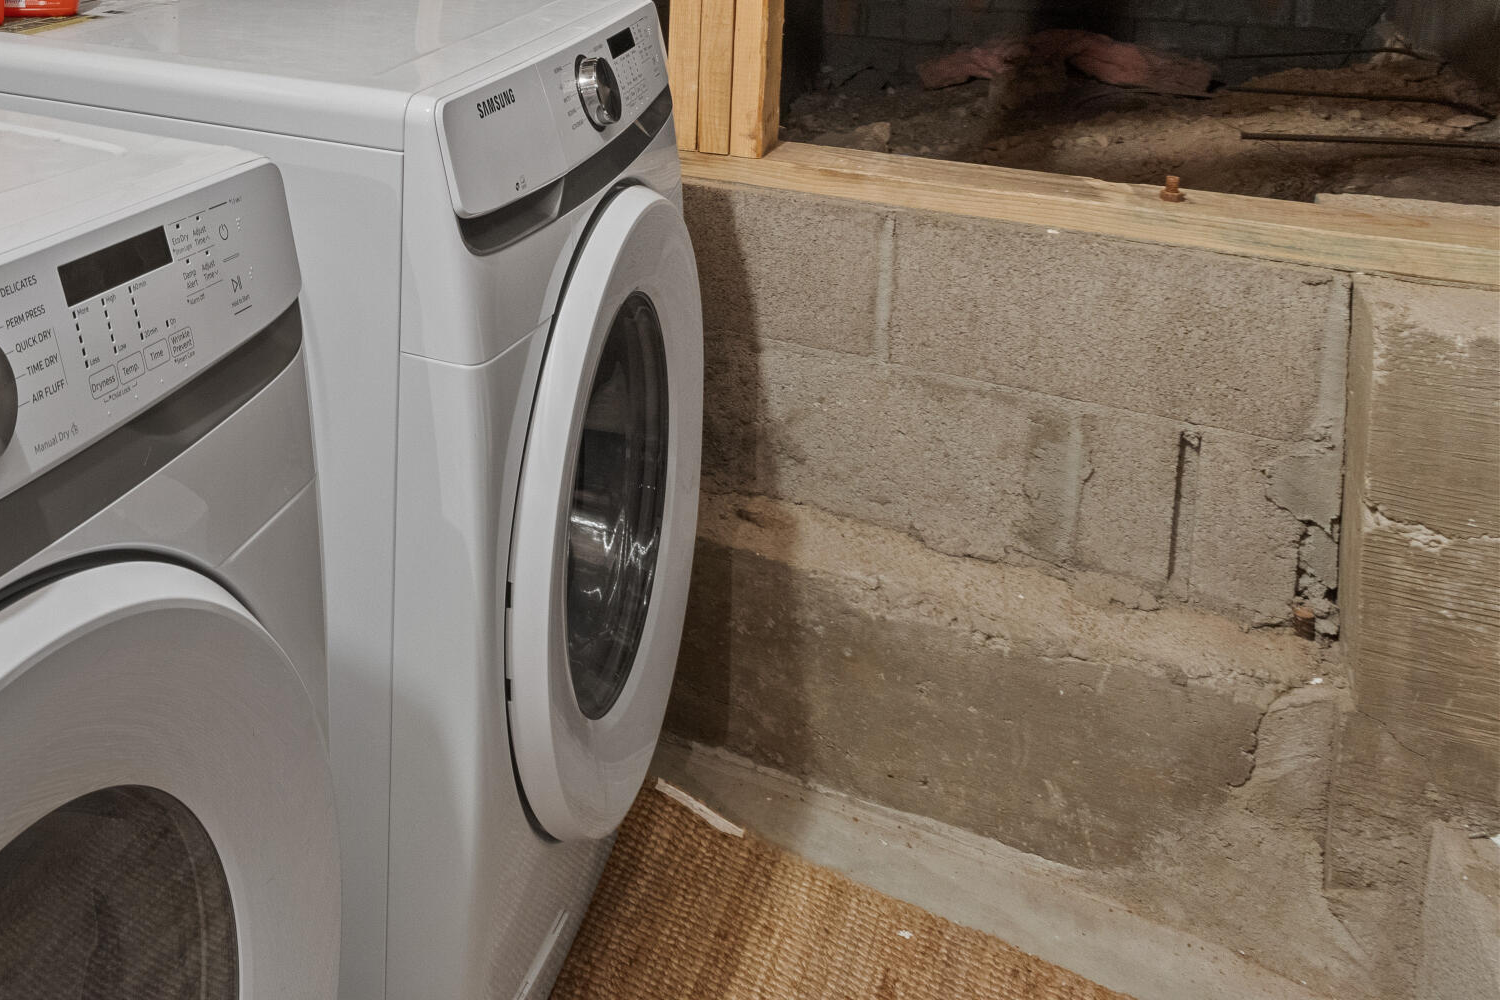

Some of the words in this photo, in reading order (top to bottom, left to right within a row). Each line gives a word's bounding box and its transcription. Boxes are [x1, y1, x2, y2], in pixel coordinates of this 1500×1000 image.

[477, 88, 515, 119] SAMSUNG
[0, 275, 37, 298] DELICATES
[6, 313, 25, 329] PERM
[25, 304, 45, 321] PRESS
[77, 307, 89, 315] More
[16, 335, 38, 353] QUICK
[38, 328, 52, 344] DRY
[171, 330, 190, 345] Wrinkle
[173, 339, 192, 354] Prevent
[27, 361, 44, 376] TIME
[44, 353, 58, 369] DRY
[150, 350, 163, 360] Time
[123, 364, 139, 376] Temp.
[32, 390, 44, 403] AIR
[44, 379, 65, 397] FLUFF
[91, 376, 116, 393] Dryness
[34, 432, 58, 455] Manual
[58, 429, 71, 444] Dry
